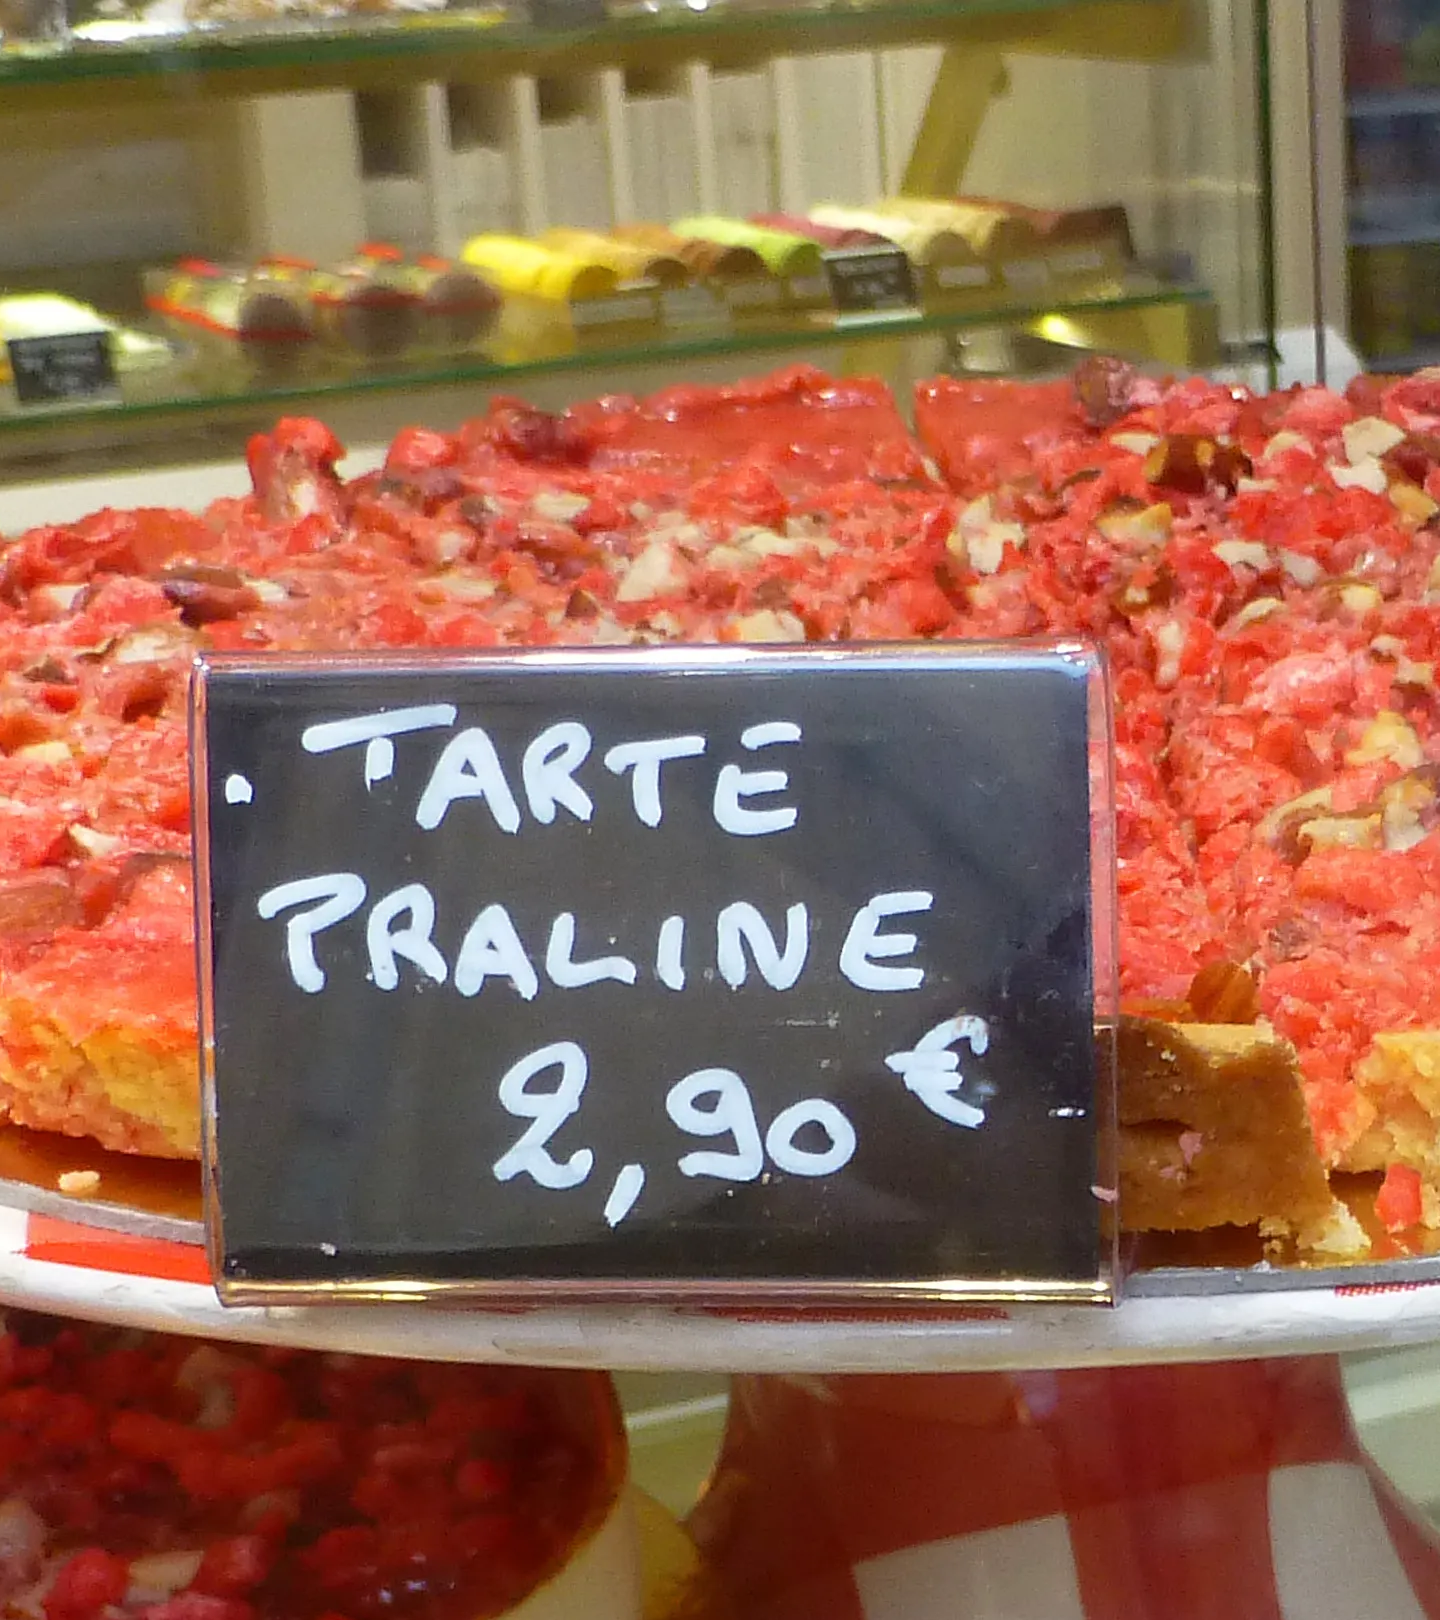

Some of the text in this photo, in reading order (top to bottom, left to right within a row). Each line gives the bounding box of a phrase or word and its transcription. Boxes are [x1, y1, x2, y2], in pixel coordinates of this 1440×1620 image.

[301, 703, 802, 834] TARTE
[257, 872, 934, 1000] PRALINE
[492, 1014, 989, 1227] 2,90 €
